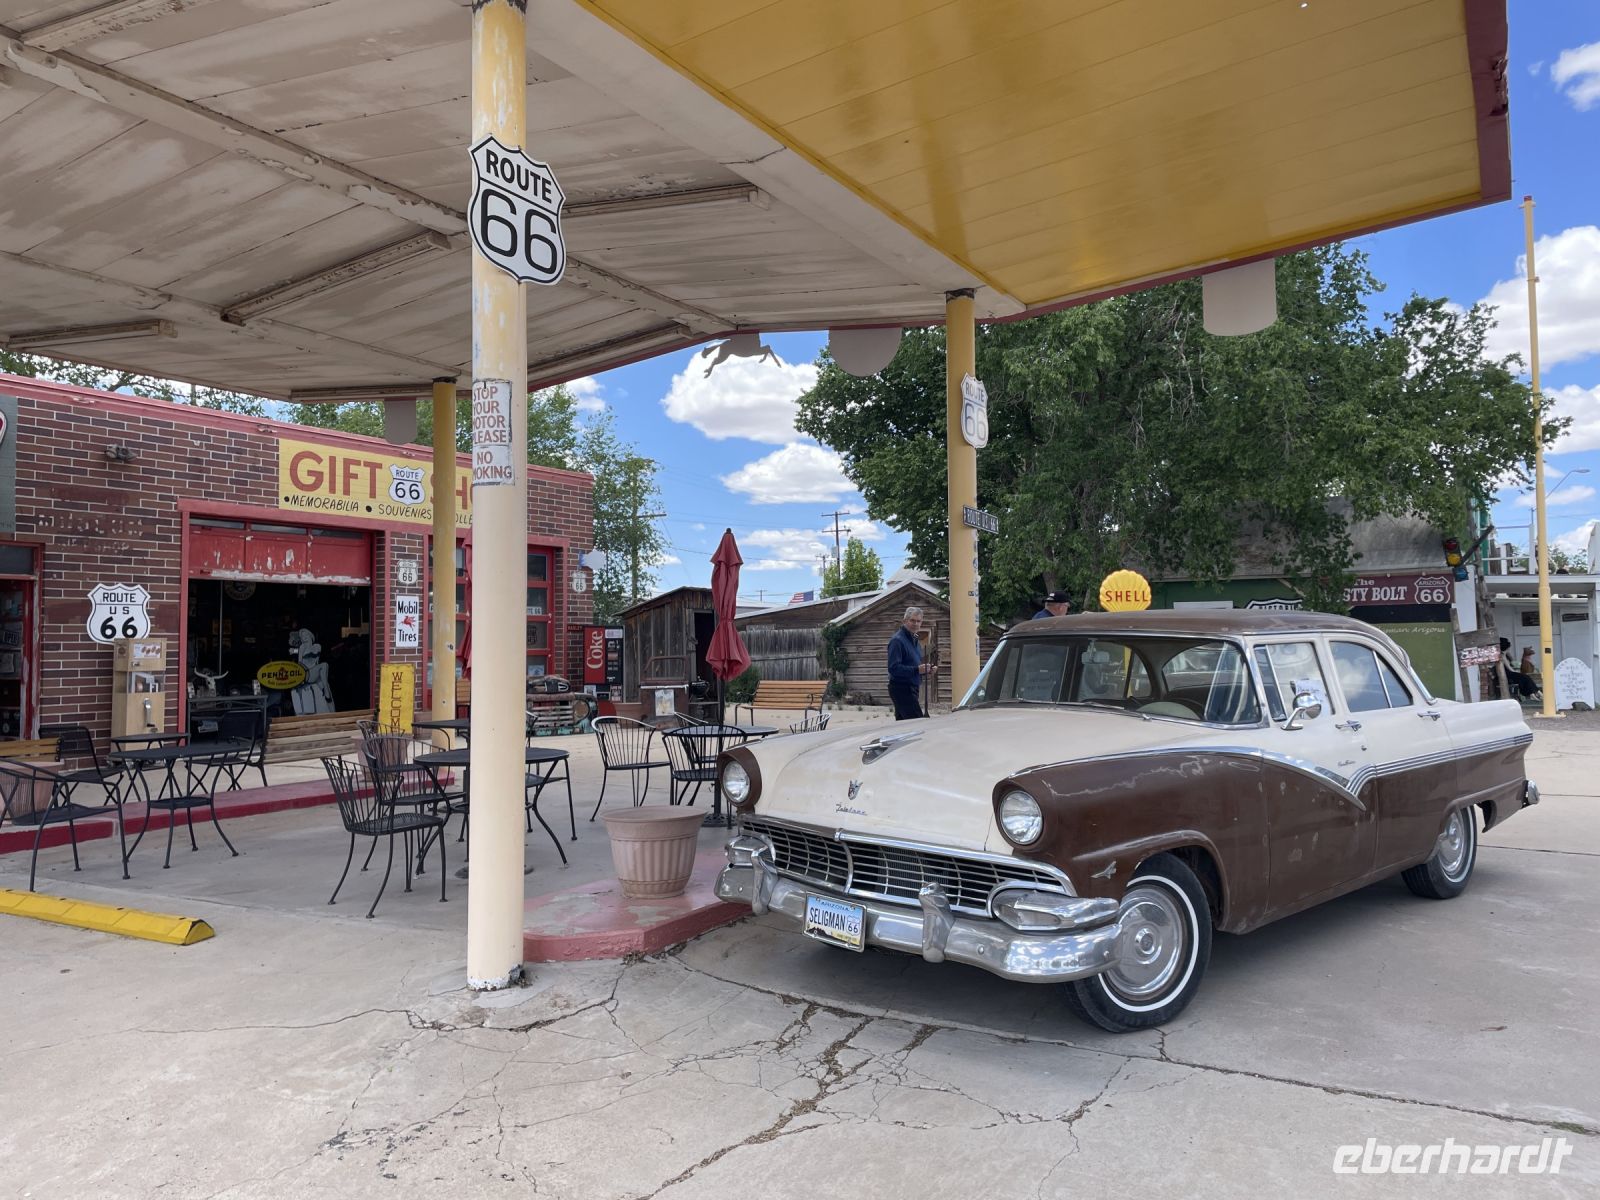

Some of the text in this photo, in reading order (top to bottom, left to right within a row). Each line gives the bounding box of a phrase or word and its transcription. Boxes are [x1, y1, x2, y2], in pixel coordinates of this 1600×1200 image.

[486, 148, 552, 204] ROUTE
[480, 188, 558, 275] 66
[965, 382, 985, 402] ROUTE
[473, 415, 506, 430] OTOR
[965, 402, 986, 441] 66
[473, 429, 507, 445] LEASE
[477, 451, 493, 465] NO
[289, 450, 383, 499] GIFT
[395, 469, 420, 480] ROUTE
[473, 465, 512, 481] OKING
[395, 482, 420, 500] 66
[290, 495, 360, 513] MEMORABILIA
[378, 503, 432, 520] SOUVENIRS
[402, 572, 413, 582] 66
[1354, 578, 1375, 586] The
[102, 592, 137, 603] ROUTE
[1105, 590, 1149, 603] SHELL
[1342, 586, 1408, 602] STY BOLT
[1420, 588, 1445, 603] 66
[397, 601, 418, 614] Mobil
[100, 616, 138, 639] 66
[398, 628, 417, 643] Tires
[586, 630, 604, 669] Coke
[261, 669, 303, 679] PENNZOIL
[821, 901, 850, 912] ARIZONA
[809, 906, 859, 934] SELIGMAN 66
